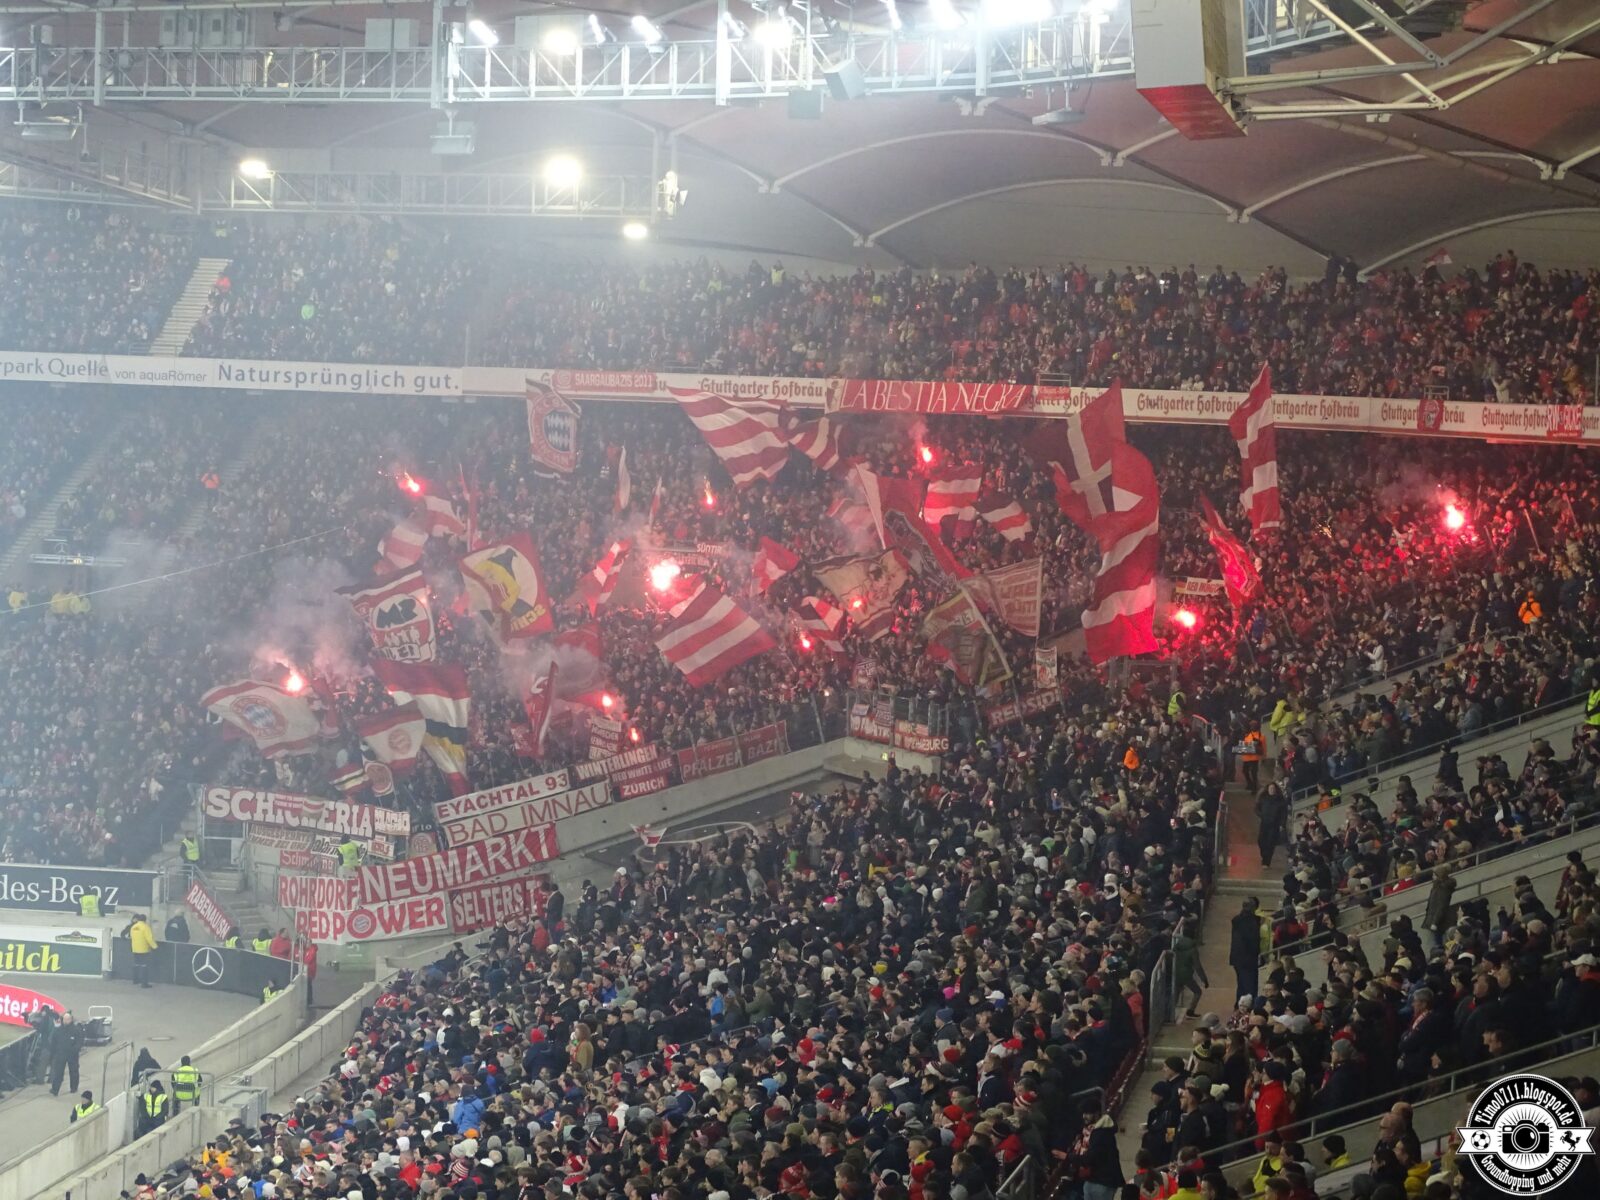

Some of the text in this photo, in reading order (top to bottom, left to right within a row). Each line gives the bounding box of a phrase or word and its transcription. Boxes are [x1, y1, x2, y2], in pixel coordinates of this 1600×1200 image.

[48, 358, 109, 378] Quelle
[115, 371, 136, 380] von
[140, 370, 207, 382] aquaRömer
[217, 364, 459, 392] Natursprünglich gut.
[1272, 399, 1318, 420] tuttgarter
[575, 743, 658, 780] WINTERLINGEN
[437, 773, 568, 819] EYACHTAL 93
[448, 811, 508, 846] BAD
[520, 783, 610, 828] IMNAU
[360, 823, 552, 903] NEUMARKT
[280, 875, 361, 911] ROHRDORF
[453, 882, 524, 927] SELTERS
[0, 943, 62, 972] ilch
